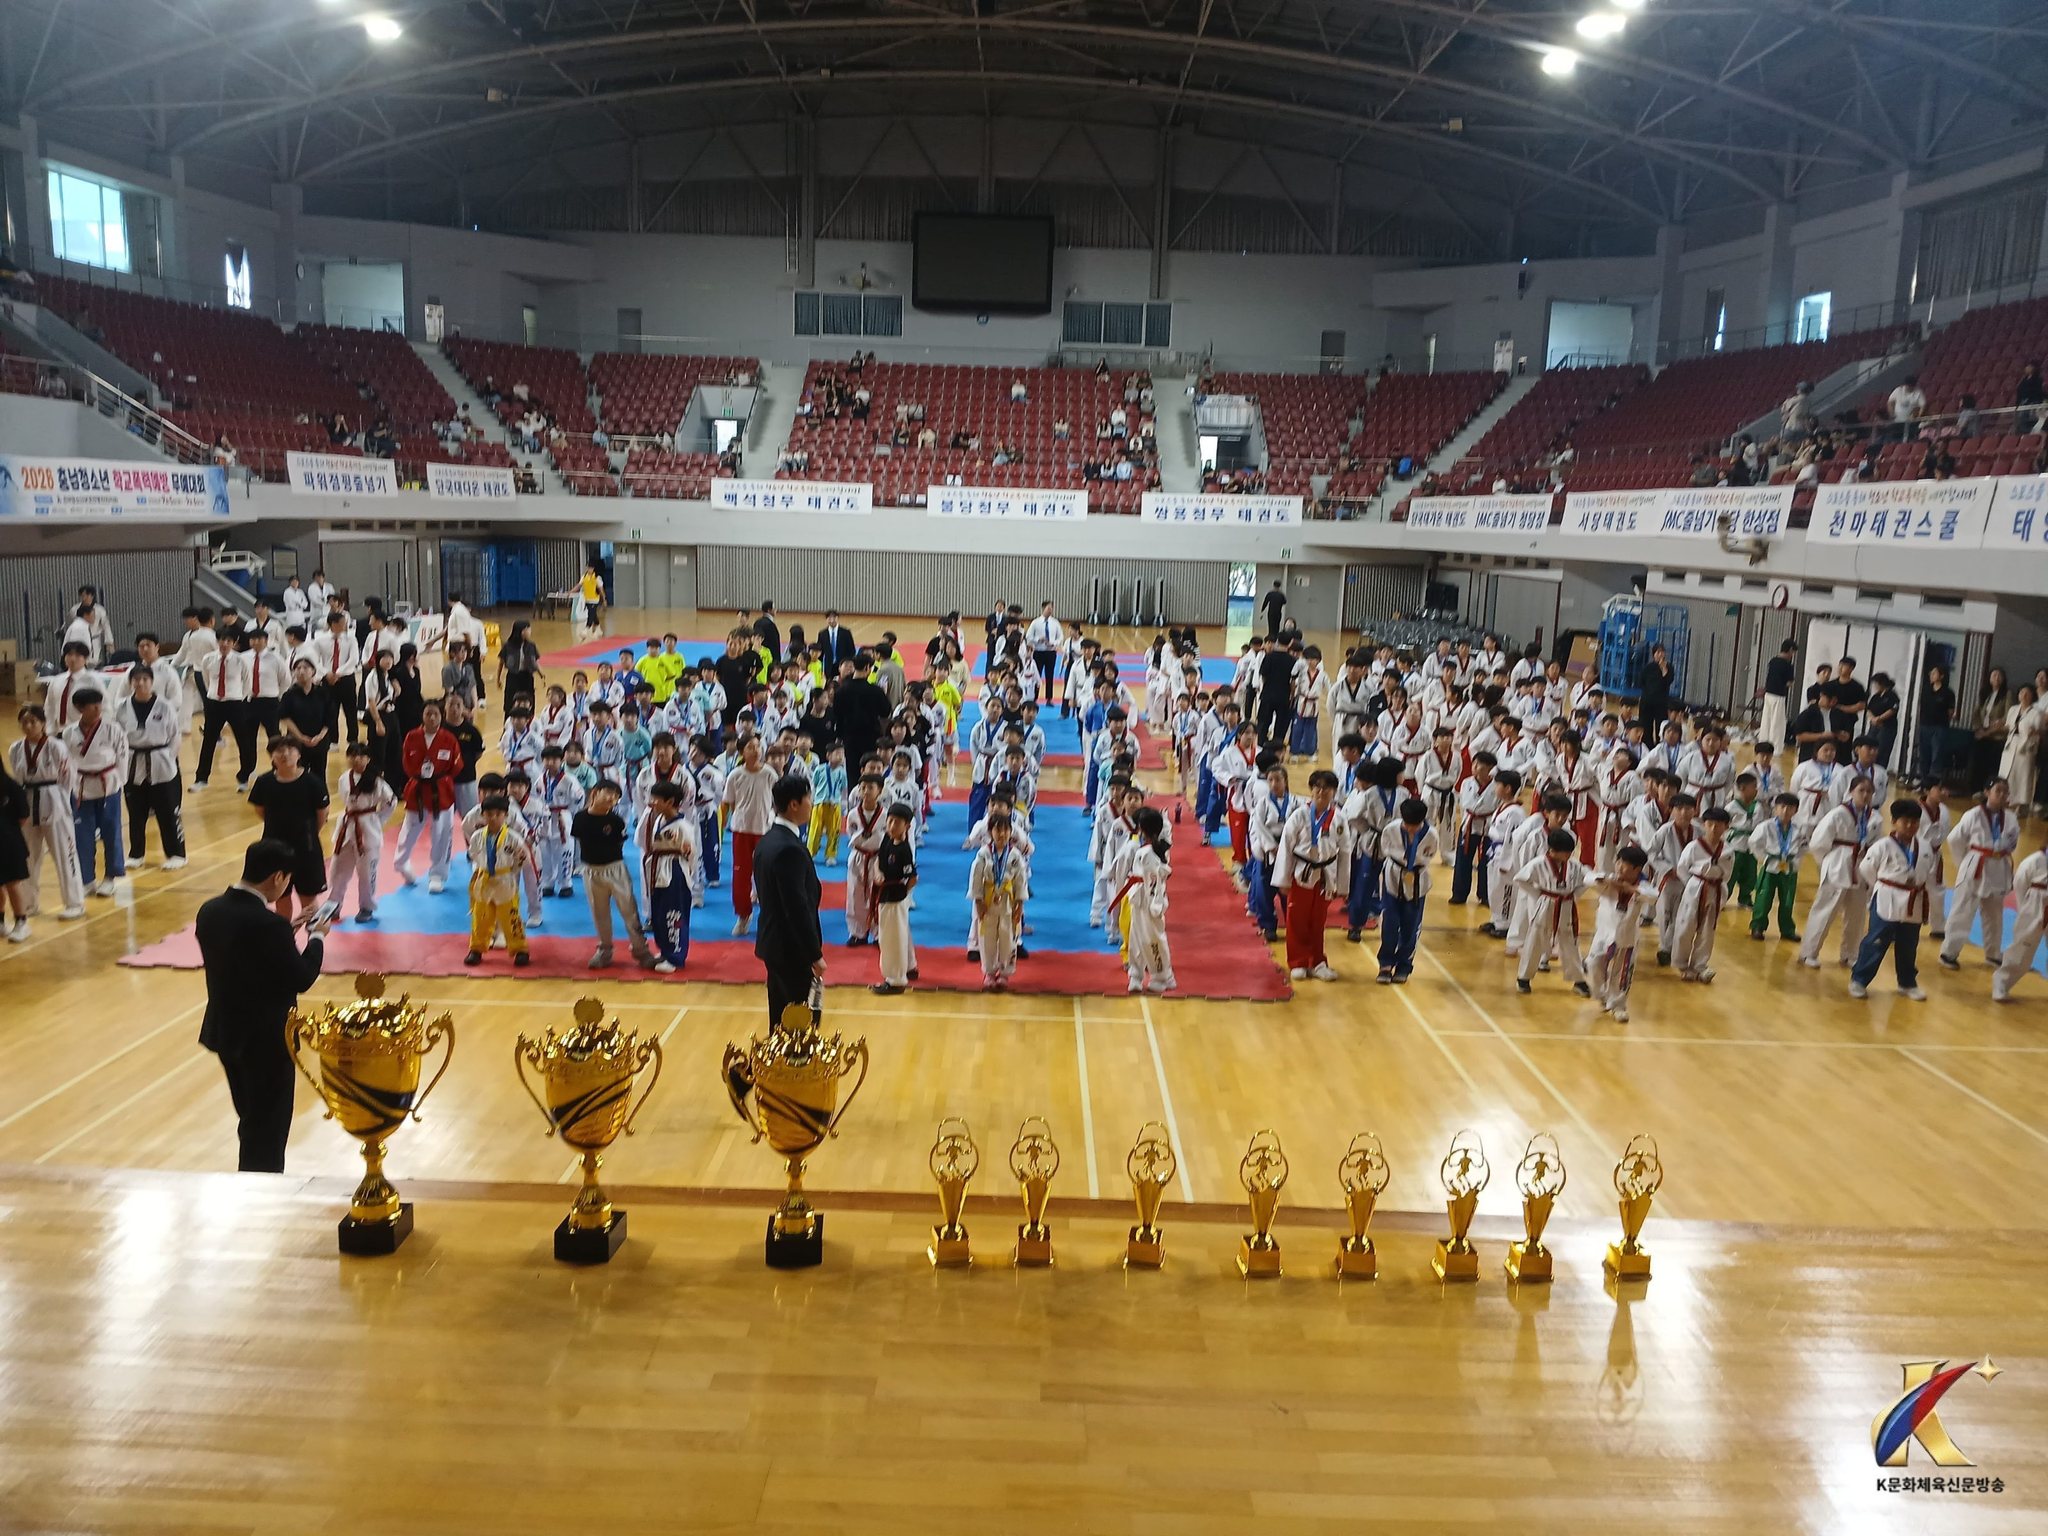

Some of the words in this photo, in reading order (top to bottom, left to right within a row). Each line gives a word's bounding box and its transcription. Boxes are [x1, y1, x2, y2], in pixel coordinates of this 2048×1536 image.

[57, 466, 111, 491] 충남청소년
[112, 469, 170, 493] 학교폭력예방
[171, 472, 207, 494] 무예대회
[303, 471, 387, 493] 파워점핑줄넘기
[483, 481, 511, 497] 태권도
[807, 495, 860, 511] 태권도
[1023, 502, 1075, 517] 태권도
[1237, 507, 1290, 523] 태권도
[1660, 508, 1718, 533] JMC줄넘기
[1828, 508, 1961, 541] 천마태권스쿨
